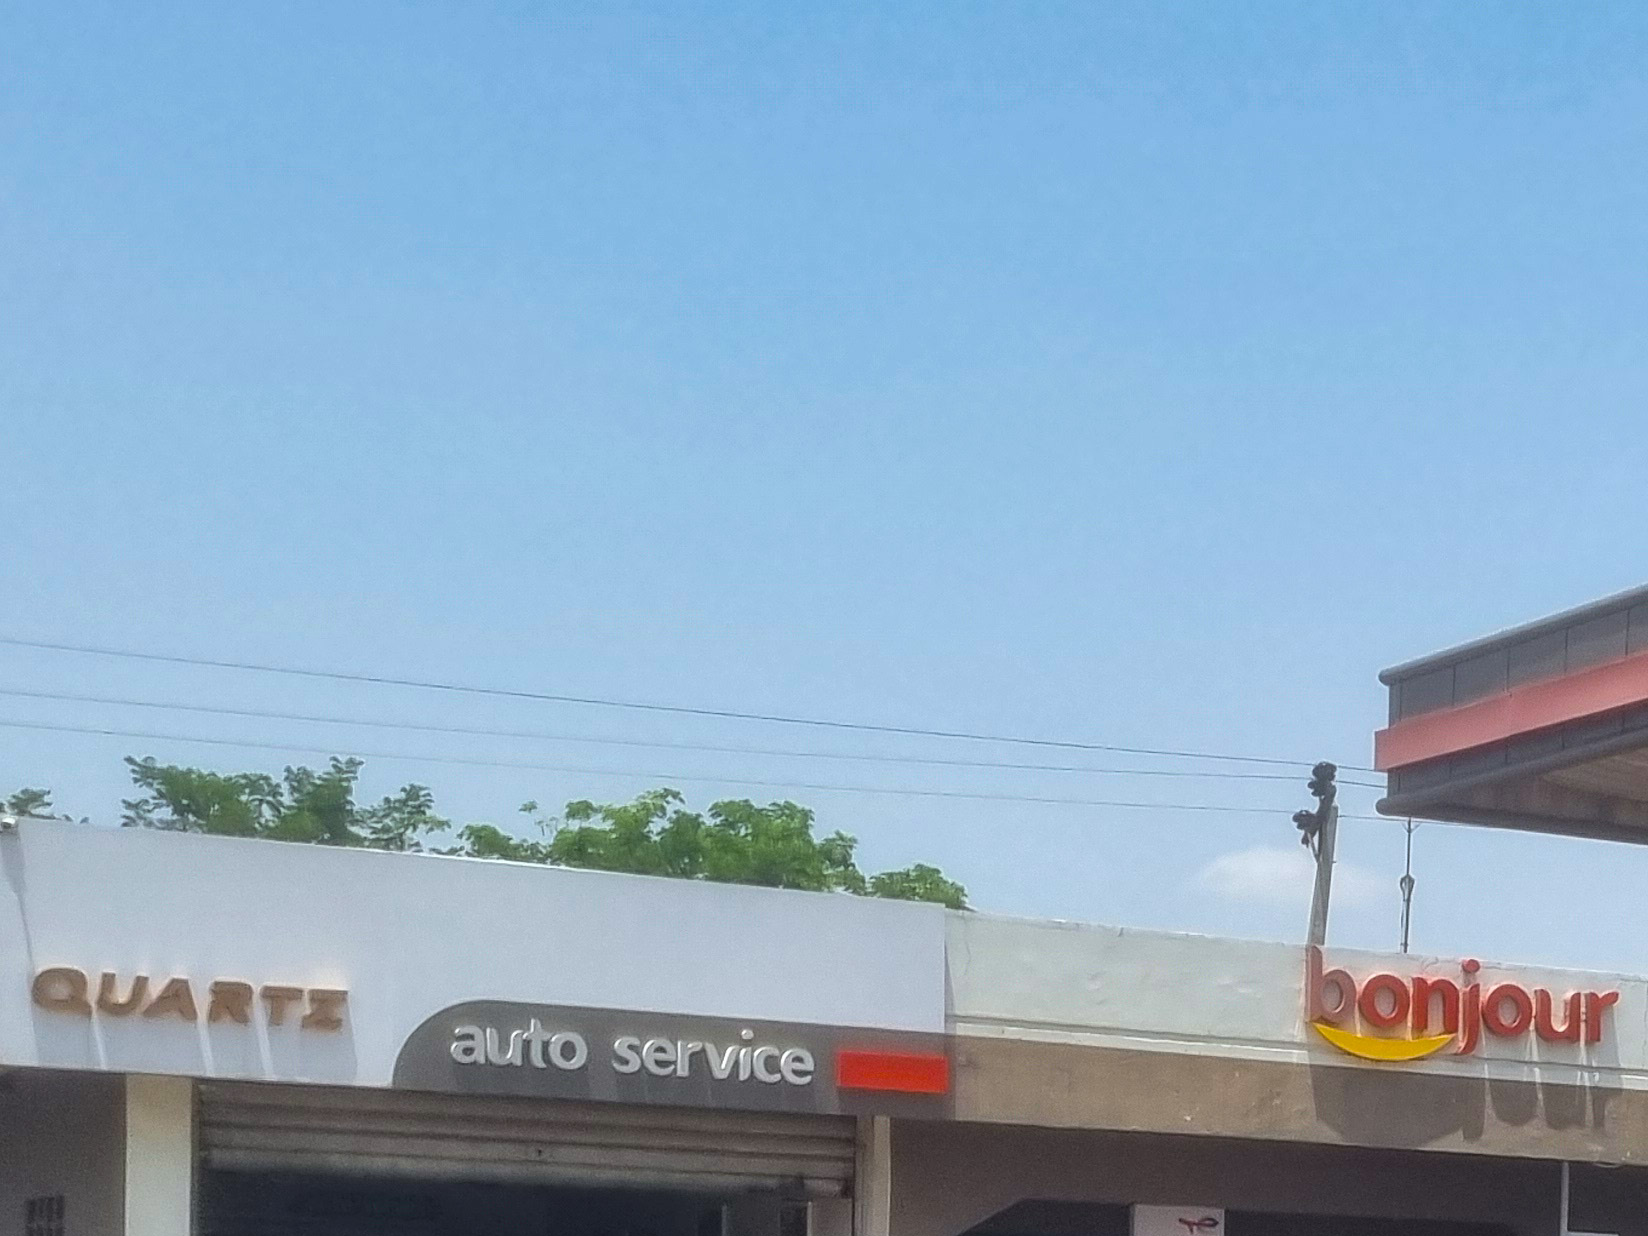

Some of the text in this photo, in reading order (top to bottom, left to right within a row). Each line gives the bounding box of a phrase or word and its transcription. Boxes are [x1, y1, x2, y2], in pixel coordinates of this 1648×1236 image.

[31, 966, 349, 1031] QUARTZ
[1305, 944, 1620, 1055] bonjour
[450, 1018, 815, 1086] auto service
